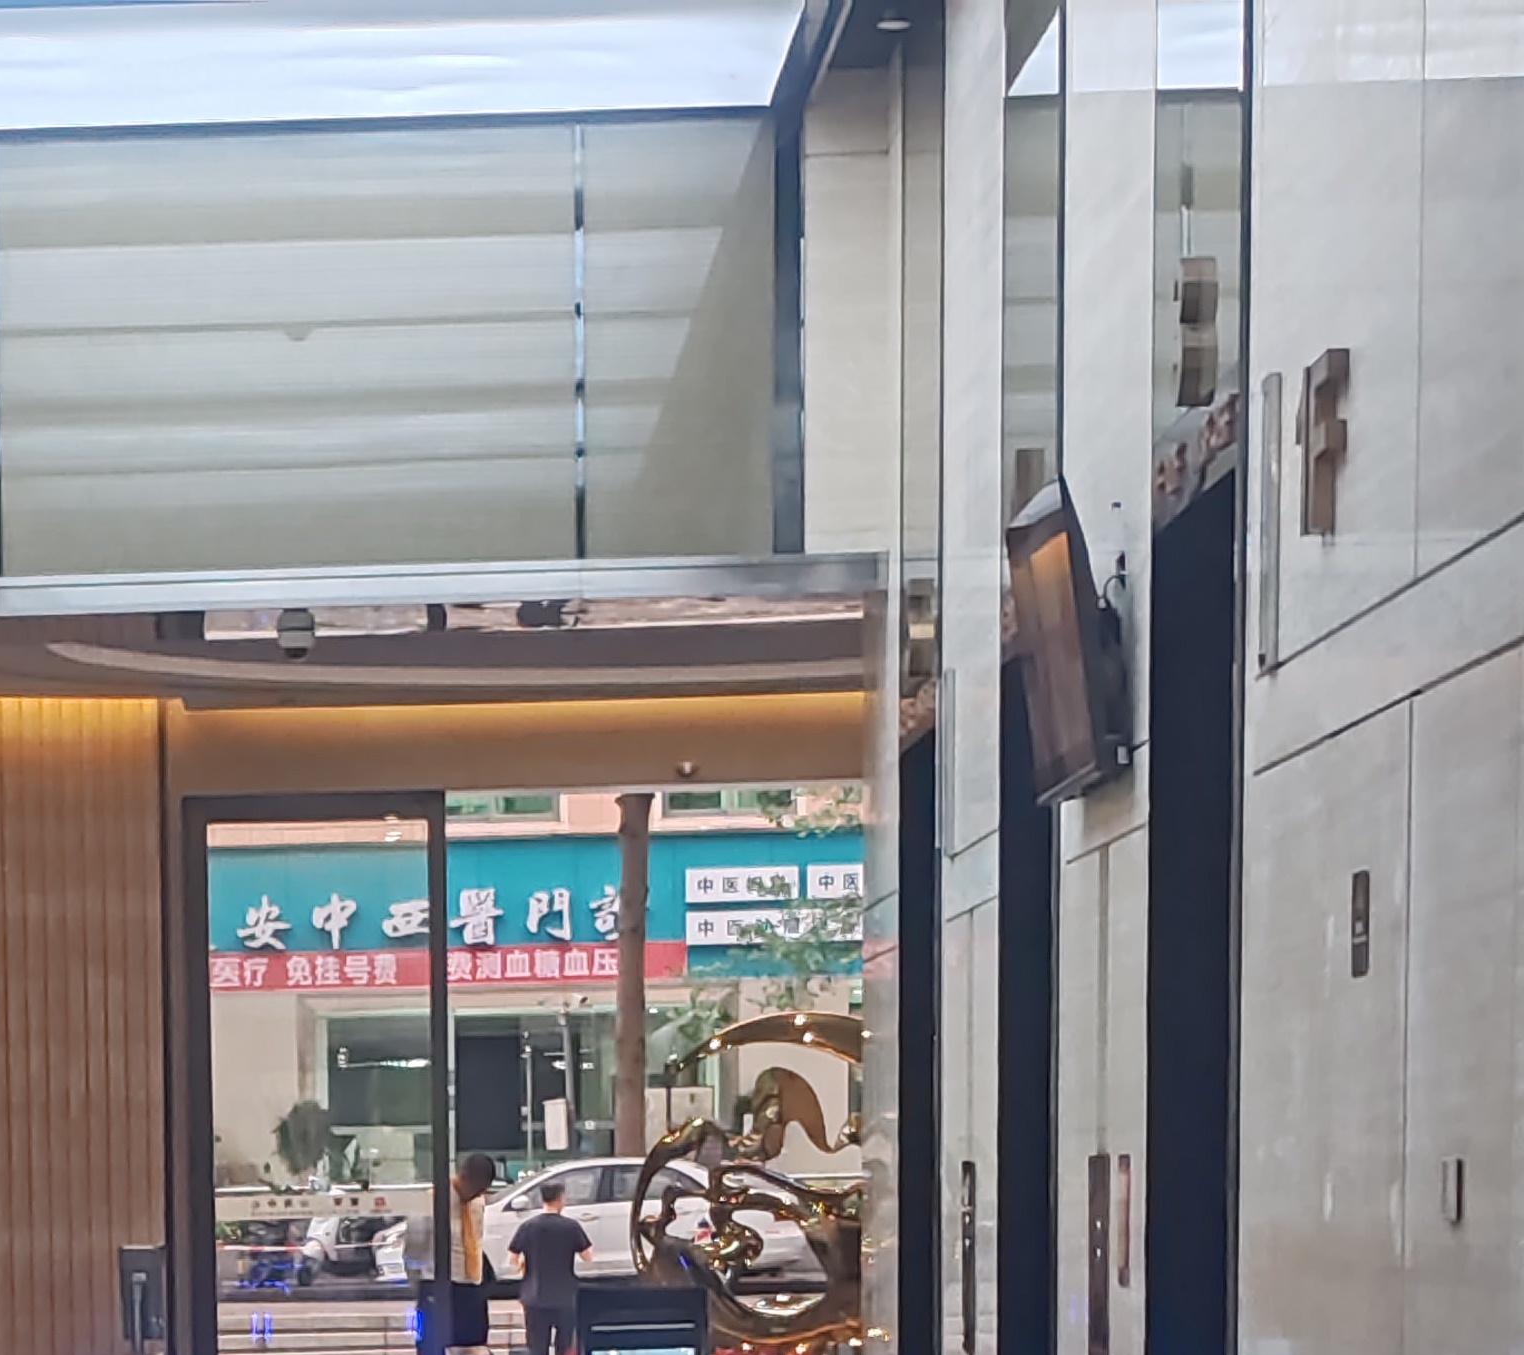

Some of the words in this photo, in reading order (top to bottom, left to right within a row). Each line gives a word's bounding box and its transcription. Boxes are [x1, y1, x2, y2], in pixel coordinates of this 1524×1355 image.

[211, 884, 620, 951] 安中西醫門
